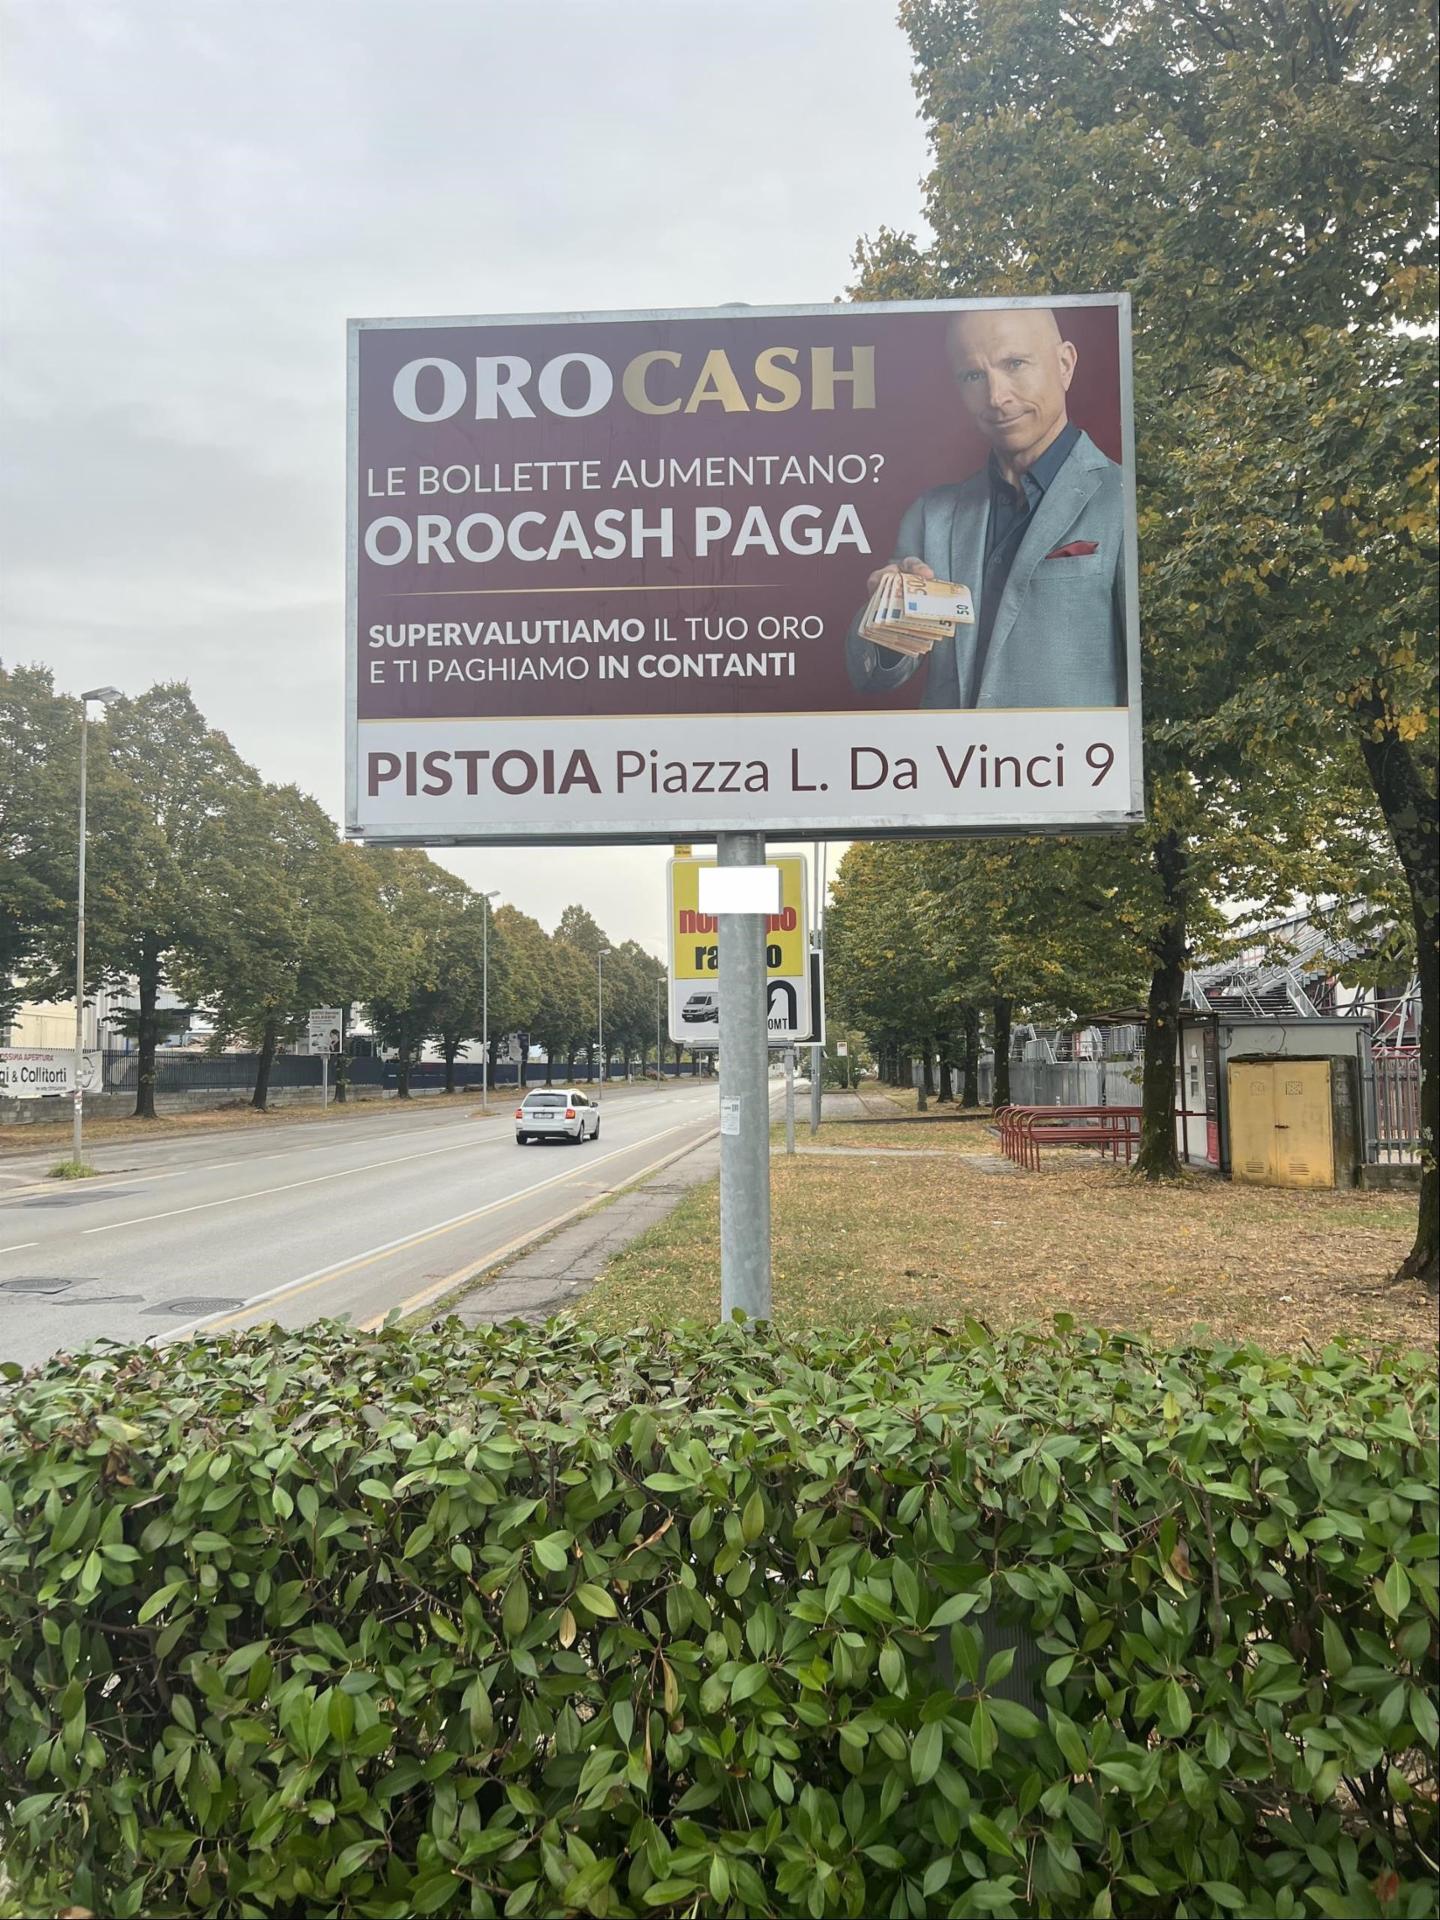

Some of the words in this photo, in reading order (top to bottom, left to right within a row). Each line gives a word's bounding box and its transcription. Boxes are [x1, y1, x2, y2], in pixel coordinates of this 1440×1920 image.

[367, 467, 406, 497] LE
[419, 460, 601, 495] BOLLETTE
[612, 453, 885, 489] AUMENTANO?
[364, 507, 674, 566] OROCASH
[695, 503, 872, 557] PAGA
[368, 618, 645, 648] SUPERVALUTIAMO
[655, 618, 677, 642] IL
[685, 617, 748, 640] TUO
[757, 615, 824, 640] ORO
[369, 661, 385, 683] E
[394, 660, 417, 683] TI
[428, 656, 589, 682] PAGHIAMO
[599, 654, 628, 679] IN
[637, 652, 796, 679] CONTANTI
[367, 749, 602, 796] PISTOIA
[616, 749, 769, 794] Piazza
[791, 748, 828, 792] L.
[851, 746, 917, 790] Da
[936, 743, 1064, 788] Vinci
[1085, 743, 1115, 787] 9
[12, 1070, 18, 1083] &
[21, 1066, 67, 1083] Collitorti
